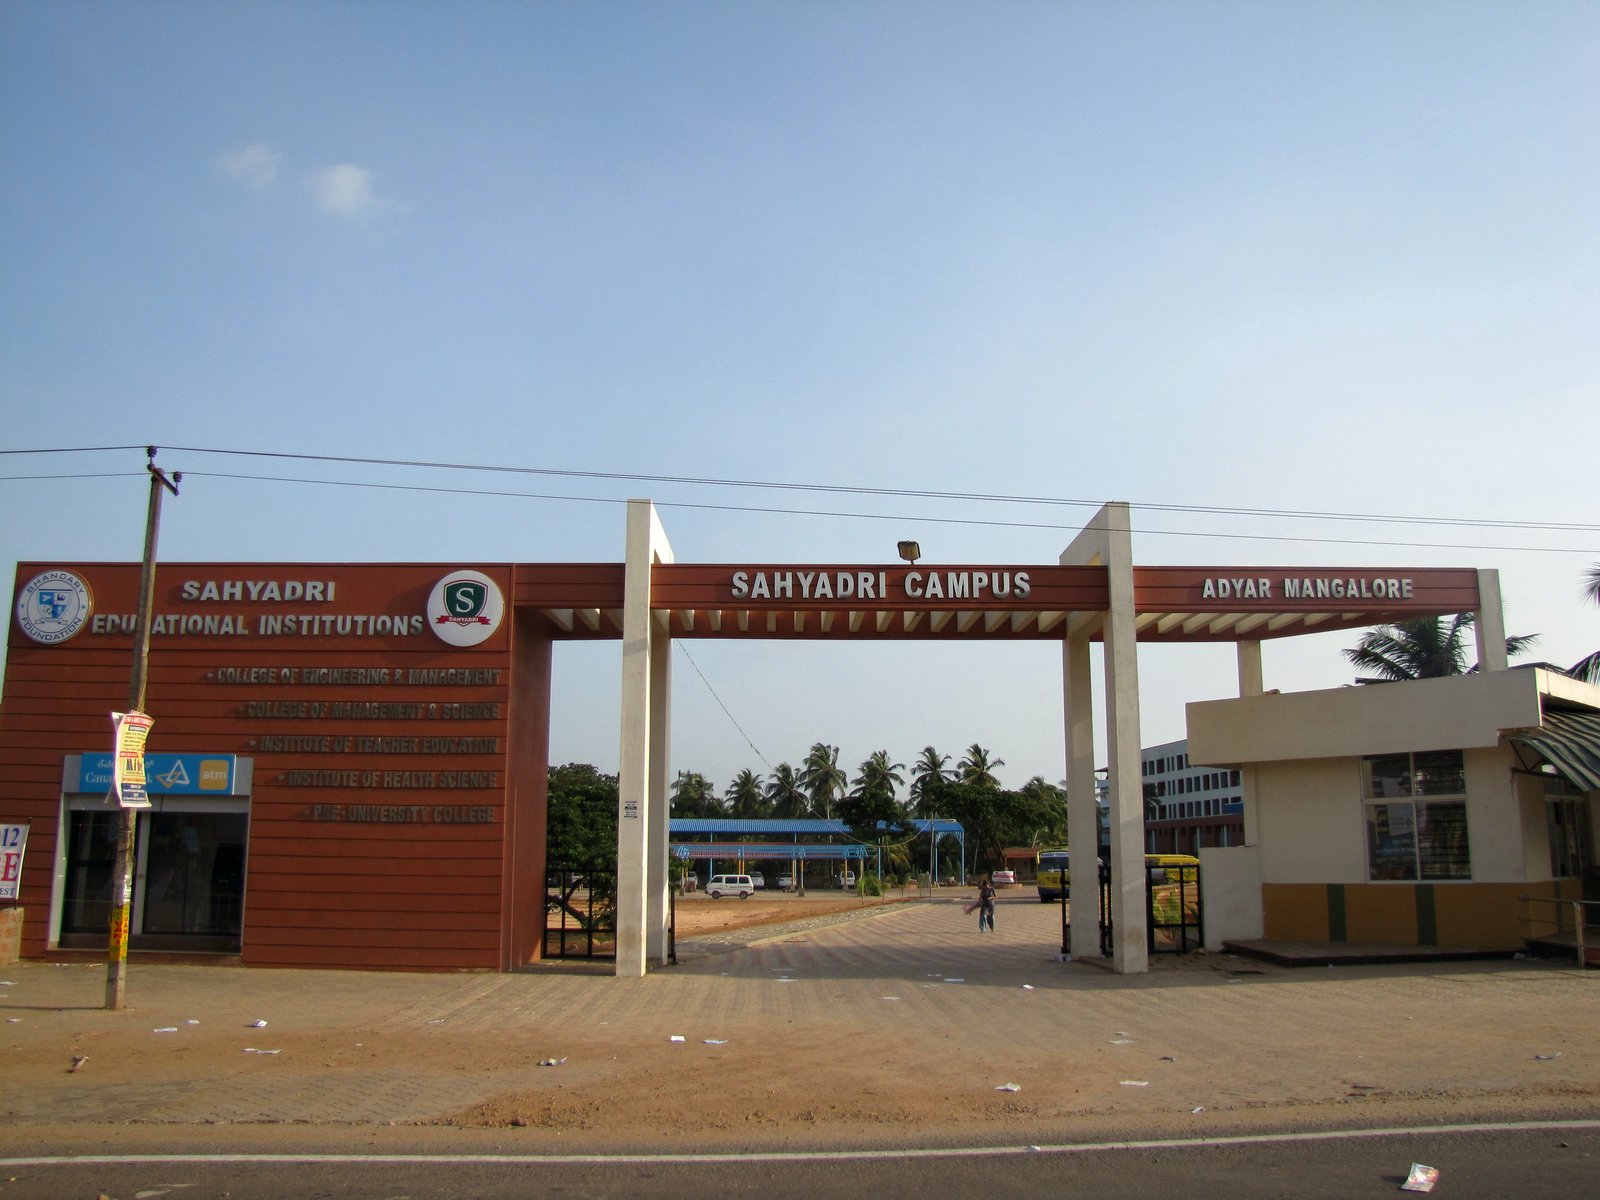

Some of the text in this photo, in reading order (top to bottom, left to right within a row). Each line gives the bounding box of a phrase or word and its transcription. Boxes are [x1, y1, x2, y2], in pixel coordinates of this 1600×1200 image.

[27, 572, 85, 594] BHANDARY
[182, 580, 335, 601] SAHYADRI
[731, 571, 1031, 599] SAHYADRI CAMPUS
[1202, 578, 1414, 600] ADYAR MANGALORE
[456, 587, 474, 613] S
[21, 616, 82, 642] FOUNDATION
[92, 614, 424, 636] EDUATIONAL INSTITUTIONS
[218, 668, 501, 685] COLLEGE OF ENGINEERING & MANAGEMENT
[248, 701, 500, 720] COLLEGE OF MANAGEMENT & SCIENCE
[260, 735, 498, 754] INSTITUTE OF TEACHER EDUCATION
[85, 772, 112, 784] Cana
[202, 770, 227, 780] atm
[288, 769, 496, 788] INSTITUTE OF HEALTH SCIENCE
[433, 805, 495, 823] COLLEGE
[0, 827, 20, 847] 12
